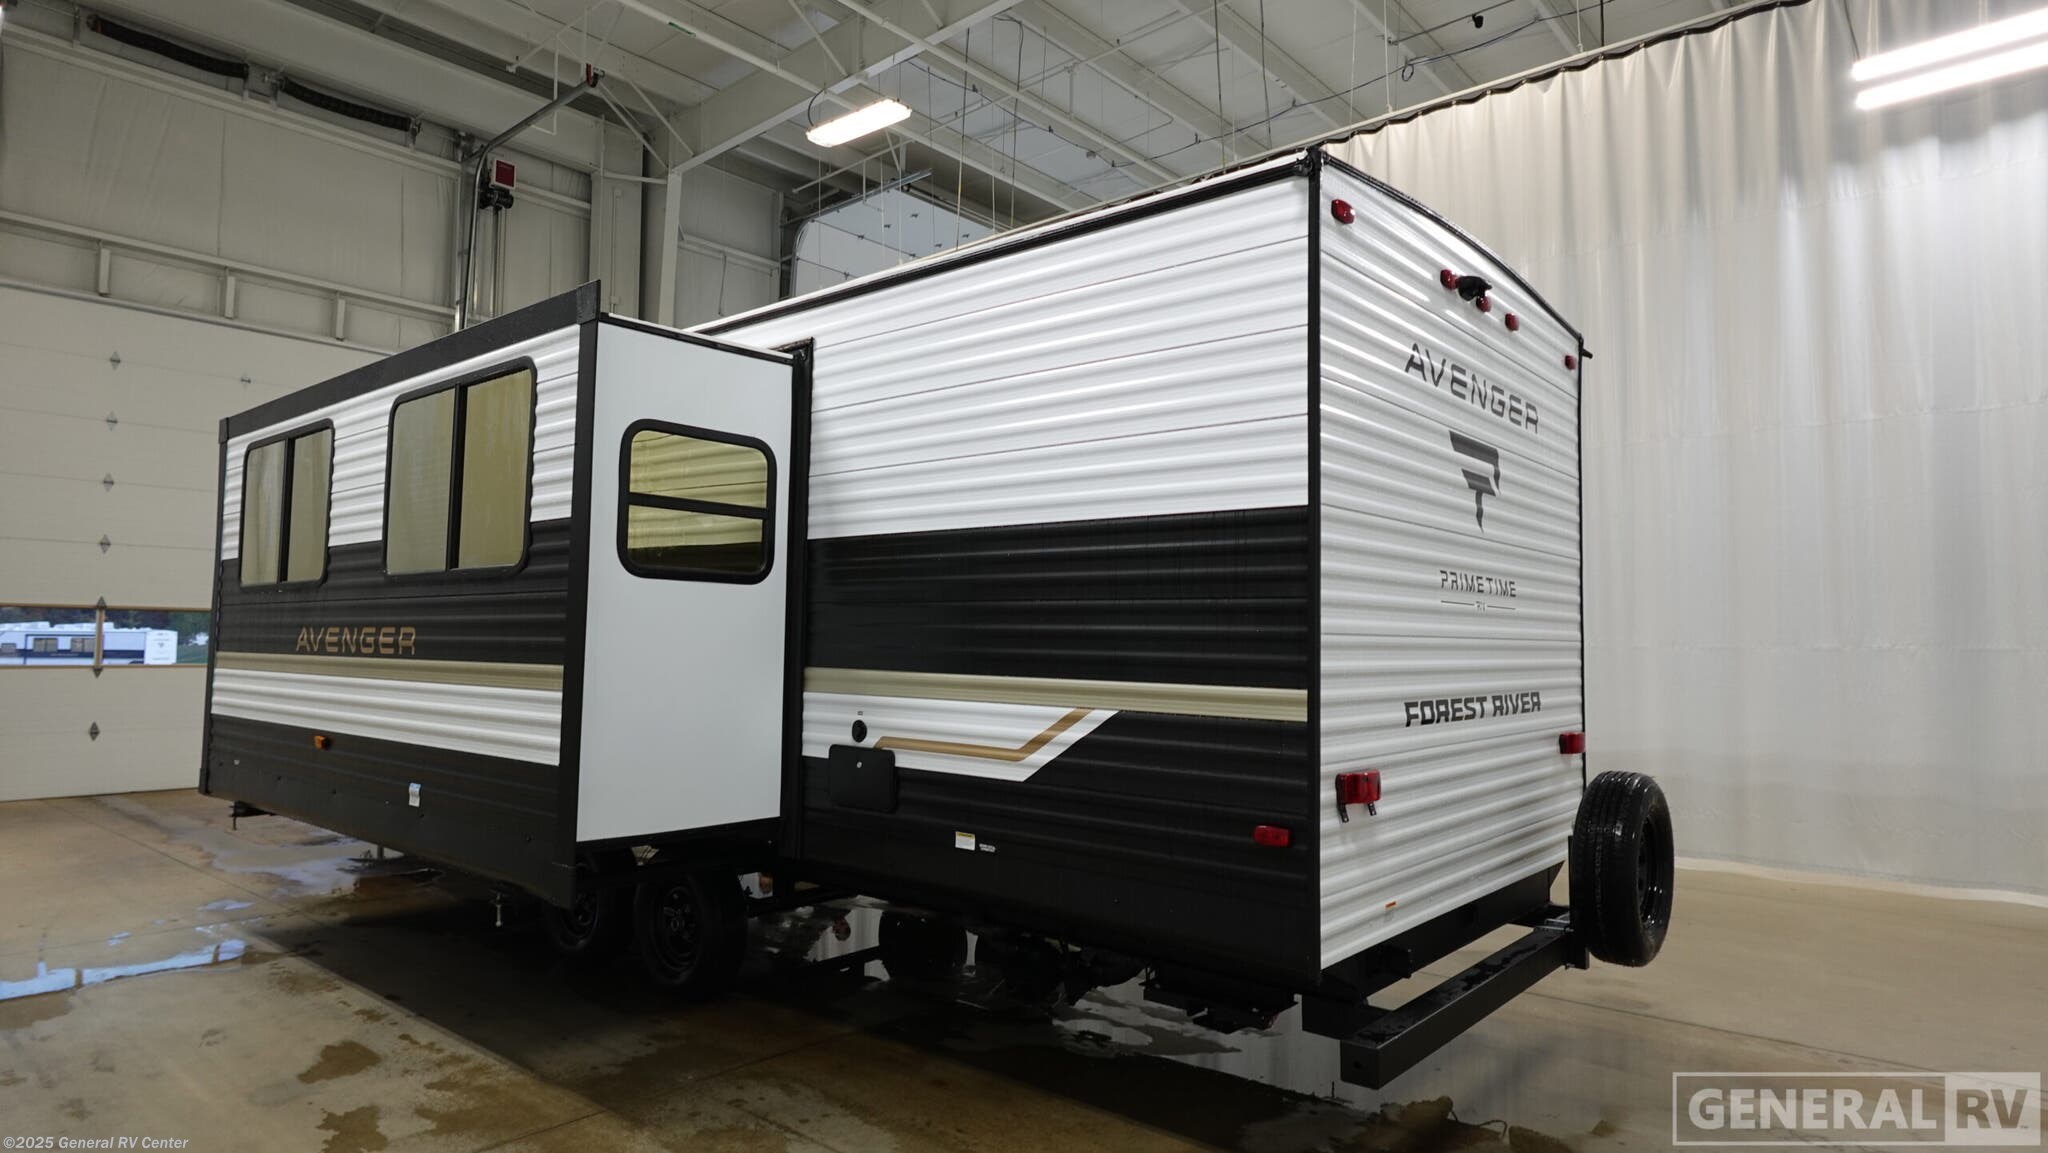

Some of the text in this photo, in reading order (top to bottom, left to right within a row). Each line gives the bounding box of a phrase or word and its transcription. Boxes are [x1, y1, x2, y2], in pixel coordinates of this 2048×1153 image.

[1405, 343, 1538, 434] AVENGER
[296, 626, 416, 655] AVENGER
[1404, 692, 1541, 727] FOREST RIVER
